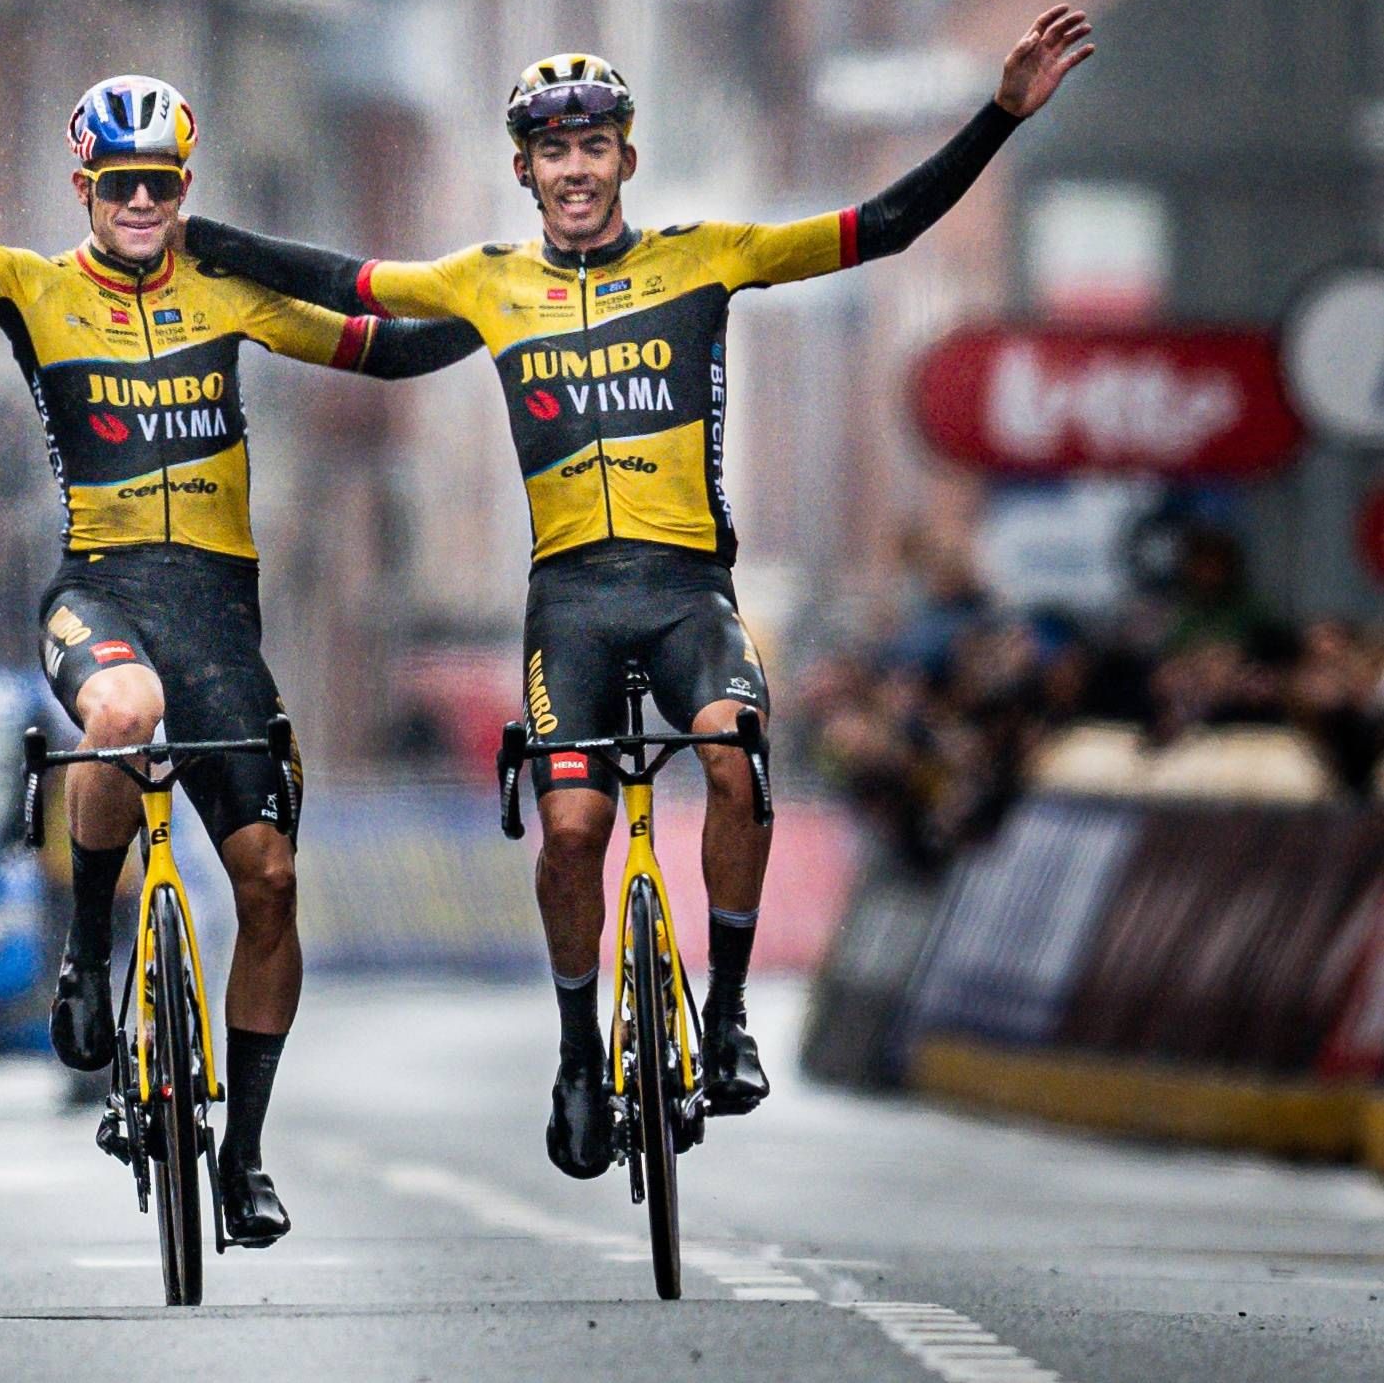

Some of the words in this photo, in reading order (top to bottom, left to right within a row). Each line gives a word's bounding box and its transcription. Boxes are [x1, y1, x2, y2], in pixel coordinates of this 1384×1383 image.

[521, 338, 672, 384] JUMBO
[86, 372, 224, 407] JUMBO
[566, 377, 673, 415] VISMA
[137, 410, 227, 442] VISMA
[560, 455, 658, 478] cervélo
[117, 477, 219, 500] cervélo
[553, 760, 585, 770] HEMA
